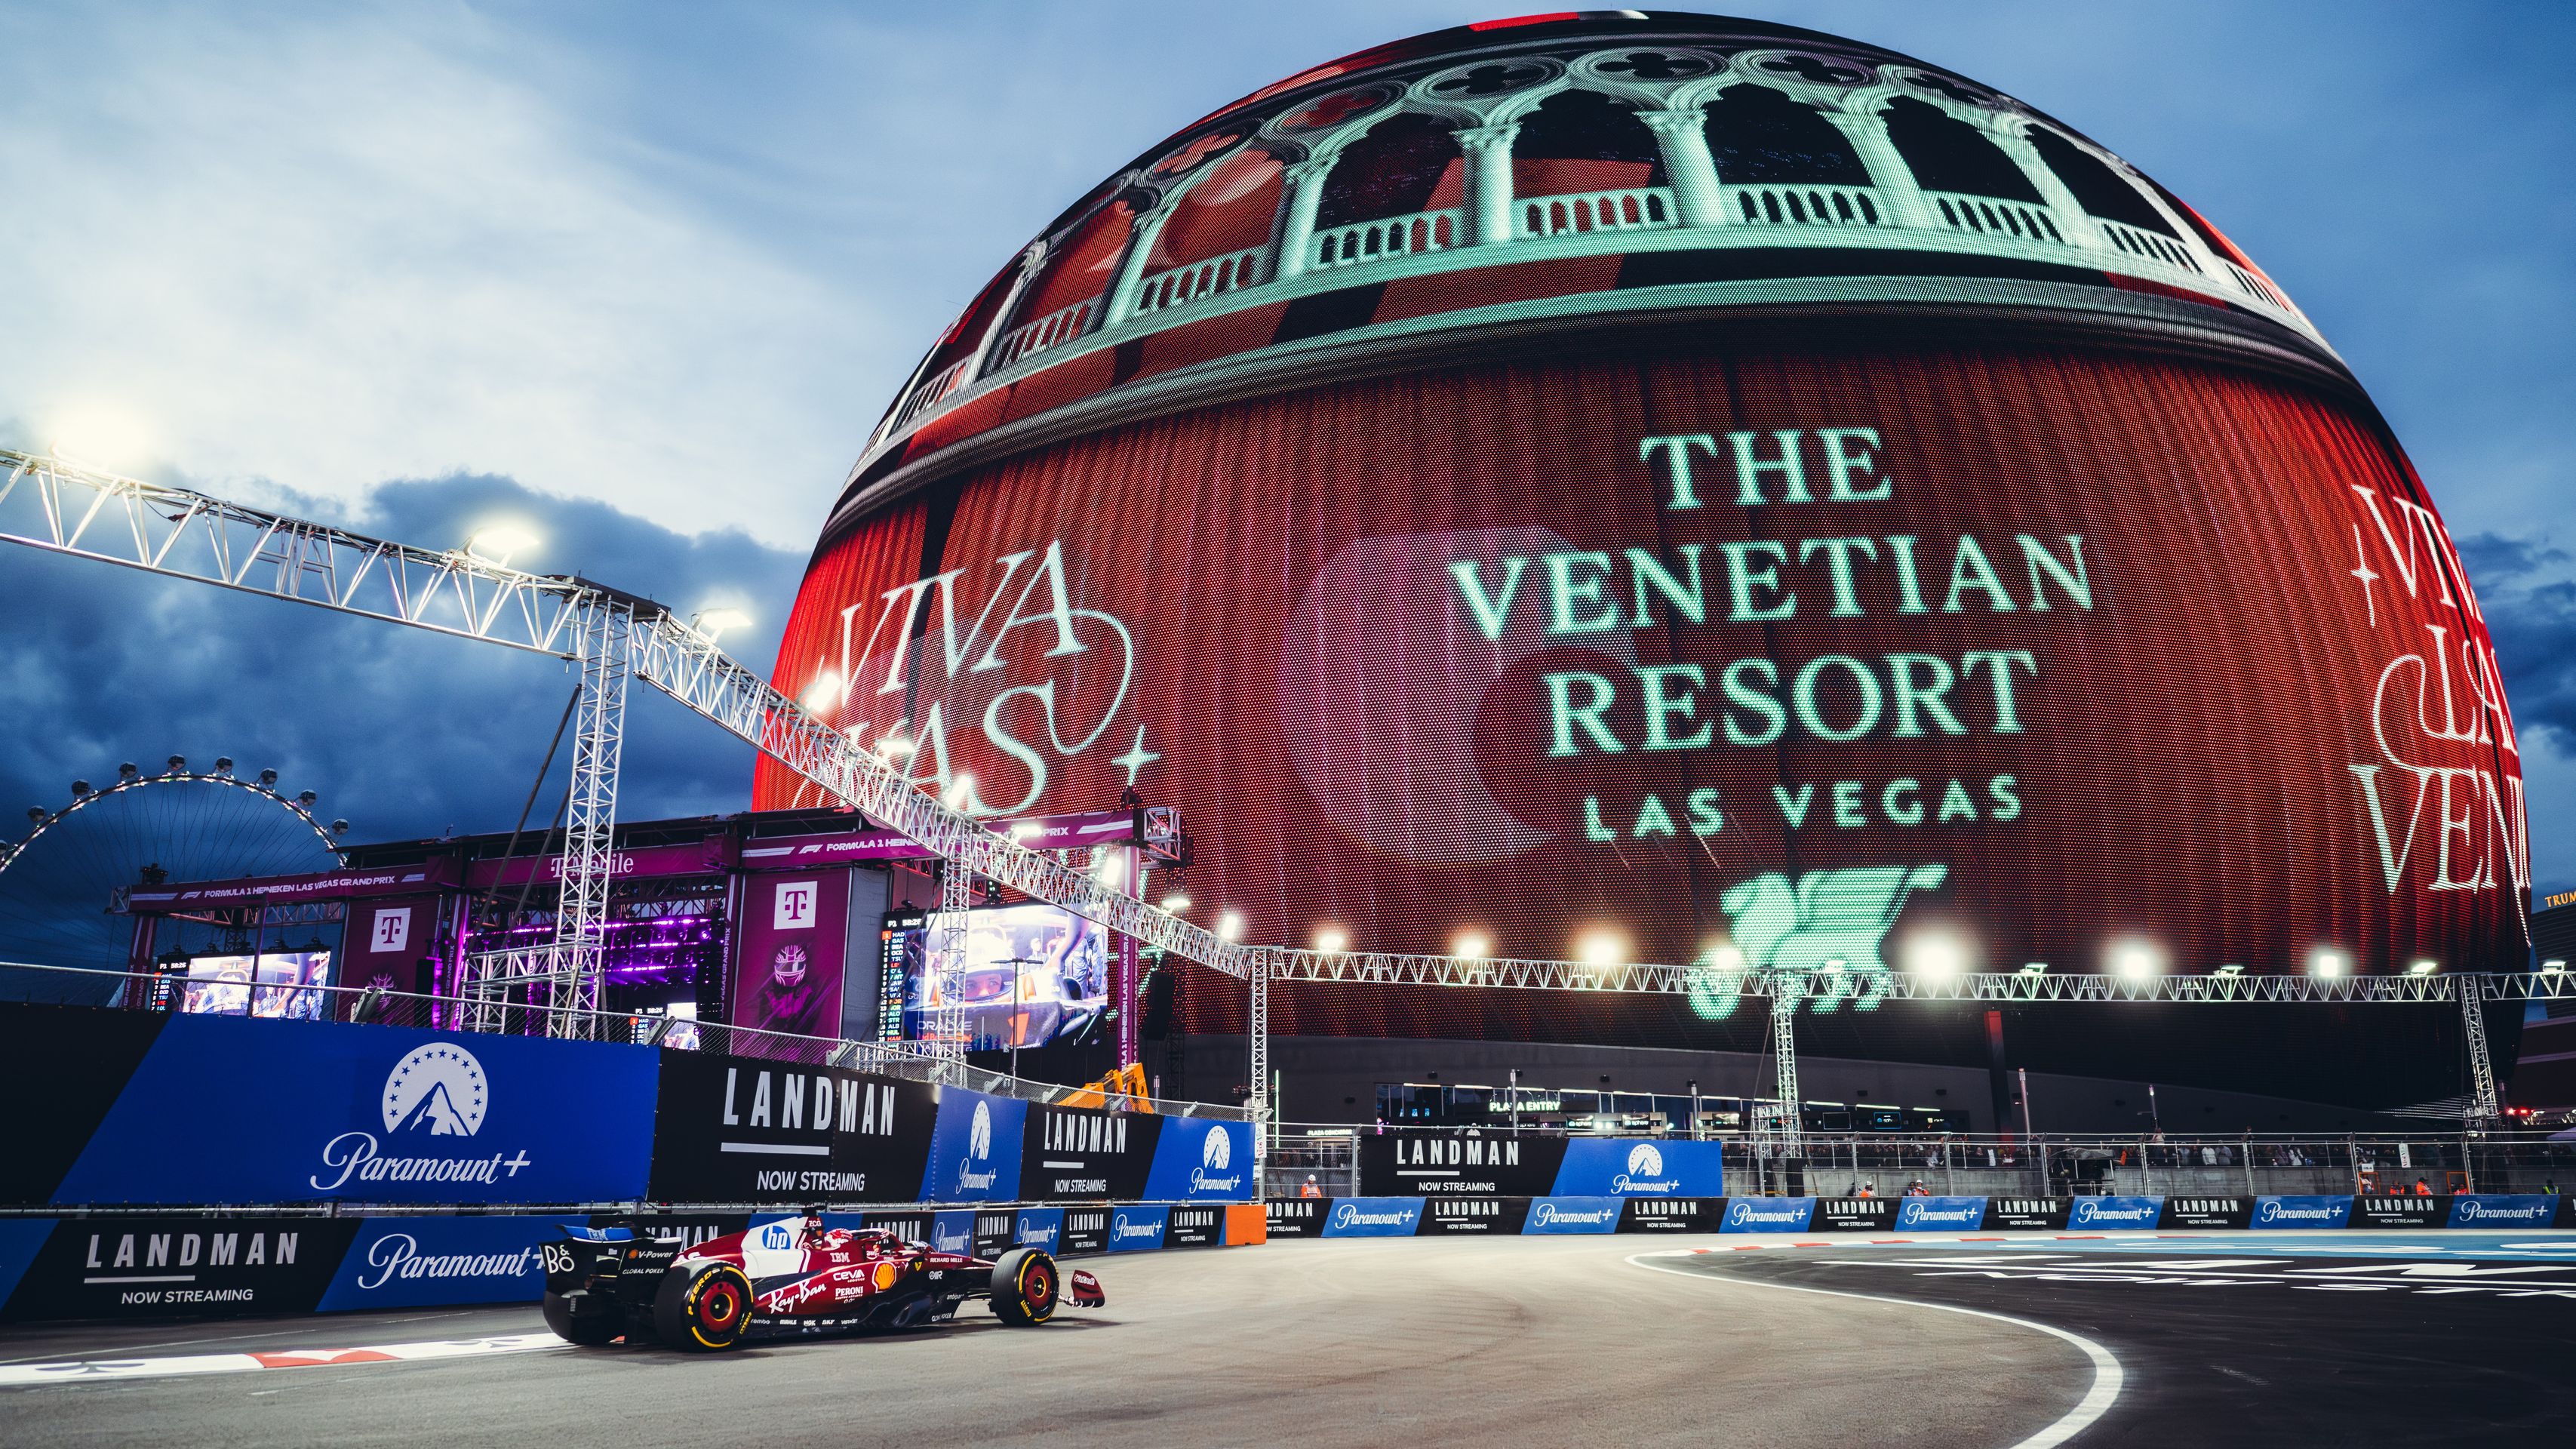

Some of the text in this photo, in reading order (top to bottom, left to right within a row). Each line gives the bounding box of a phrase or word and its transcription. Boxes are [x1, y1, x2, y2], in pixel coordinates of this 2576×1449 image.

[1640, 427, 1892, 510] THE
[1449, 533, 2094, 641] VENETIAN
[840, 539, 1132, 709] VIVA
[1542, 650, 2039, 756] RESORT
[1585, 774, 2023, 842] LAS VEGAS
[1042, 826, 1069, 837] PRIX
[826, 839, 876, 851] FORMULA
[878, 839, 884, 848] 1
[204, 888, 244, 898] FORMULA
[252, 884, 295, 895] HEINEKEN
[296, 882, 313, 891] LAS
[314, 878, 339, 889] VEGAS
[340, 876, 373, 887] GRAND
[373, 875, 395, 884] PRIX
[783, 891, 808, 920] T
[723, 1067, 895, 1135] LANDMAN
[1489, 1100, 1561, 1112] PLAA ENTRY
[1045, 1111, 1126, 1152] LANDMAN
[310, 1131, 530, 1189] Paramount+
[1397, 1140, 1518, 1165] LANDMAN
[758, 1171, 865, 1191] NOW STREAMING
[956, 1157, 996, 1194] Paramount+
[1055, 1180, 1106, 1192] NOW STREAMING
[1189, 1166, 1240, 1193] Paramount+
[1611, 1174, 1680, 1194] Paramount+
[1419, 1183, 1495, 1191] NOW STREAMING
[1266, 1203, 1312, 1217] NDMAN
[1436, 1202, 1499, 1215] LANDMAN
[1535, 1204, 1613, 1226] Paramount+
[1635, 1202, 1696, 1214] LANDMAN
[1732, 1203, 1806, 1225] Paramount+
[1826, 1201, 1884, 1214] LANDMAN
[1905, 1203, 1978, 1224] Paramount+
[1997, 1201, 2056, 1213] LANDMAN
[2078, 1202, 2153, 1223] Paramount+
[2175, 1200, 2237, 1212] LANDMAN
[2261, 1201, 2343, 1222] Paramount+
[2365, 1199, 2433, 1211] LANDMAN
[2460, 1201, 2547, 1221] Paramount+
[979, 1217, 1008, 1236] LANDMAN
[1069, 1214, 1103, 1231] LANDMAN
[1175, 1211, 1213, 1226] LANDMAN
[1336, 1204, 1413, 1229] Paramount+
[767, 1226, 788, 1250] hp
[1019, 1218, 1056, 1244] Paramount+
[1114, 1214, 1162, 1241] Paramount+
[87, 1233, 297, 1268] LANDMAN
[830, 1252, 850, 1263] IBM
[122, 1289, 253, 1303] NOW STREAMING
[690, 1271, 712, 1304] ZERO
[835, 1286, 864, 1297] PERONI
